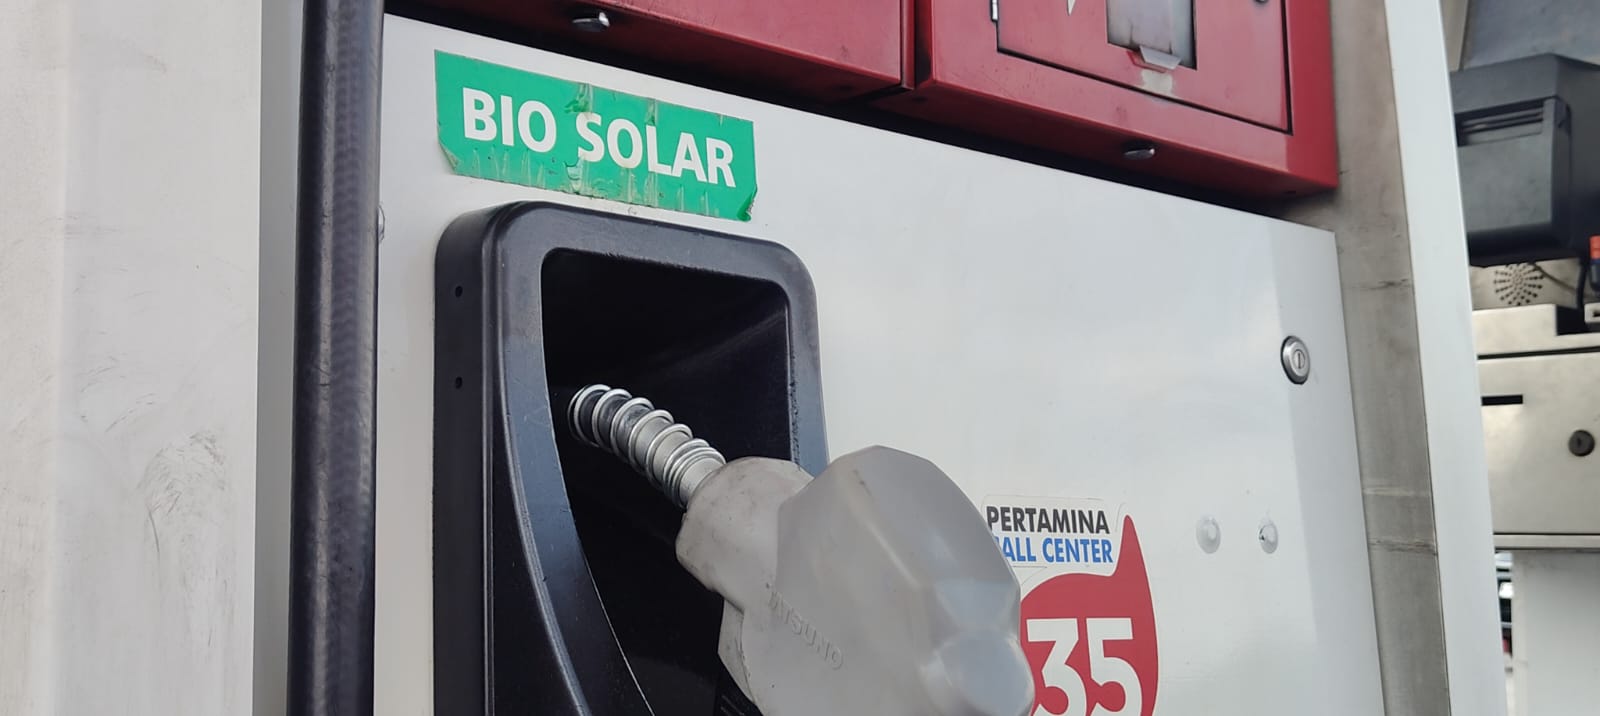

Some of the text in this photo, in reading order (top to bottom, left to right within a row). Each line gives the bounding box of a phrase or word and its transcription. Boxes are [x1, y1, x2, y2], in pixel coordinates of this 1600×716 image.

[462, 87, 736, 188] BIO SOLAR
[986, 506, 1110, 534] PERTAMINA
[994, 536, 1113, 563] ALL CENTER
